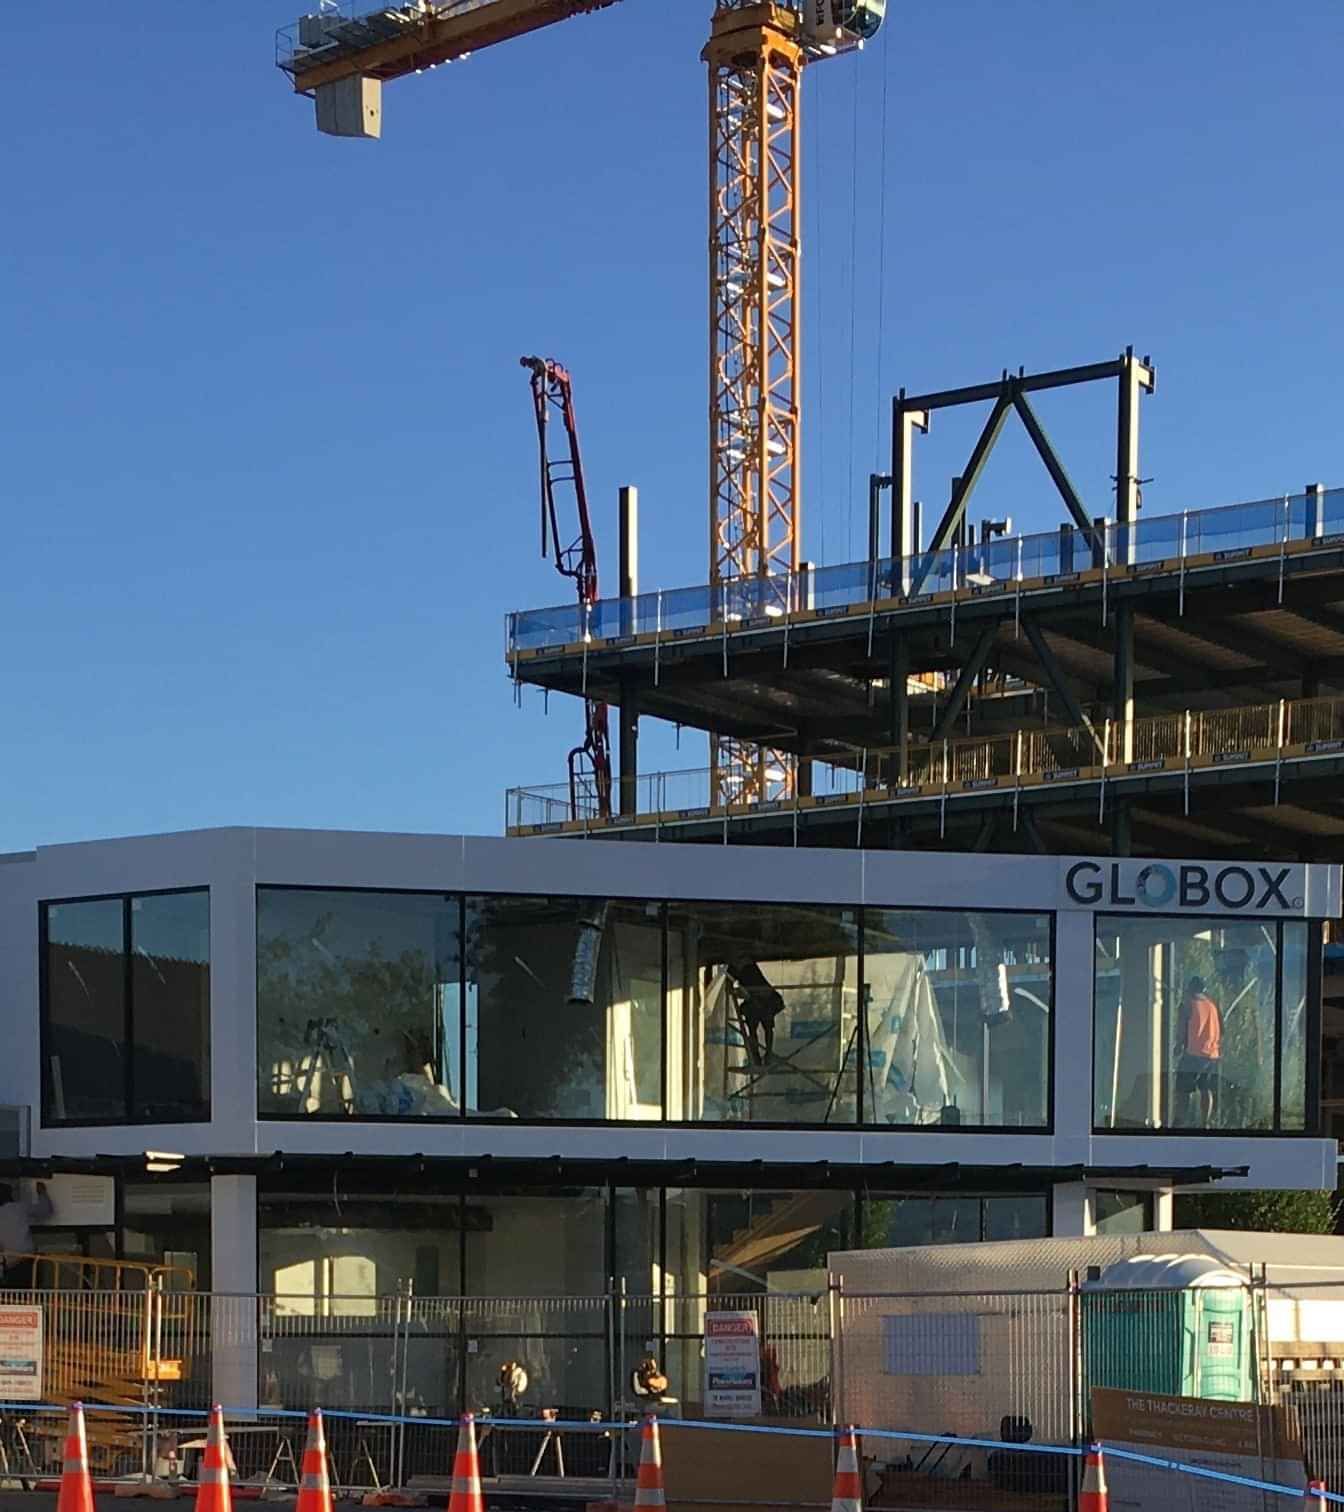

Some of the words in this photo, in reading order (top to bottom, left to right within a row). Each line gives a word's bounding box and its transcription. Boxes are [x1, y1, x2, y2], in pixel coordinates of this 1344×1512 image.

[1065, 861, 1292, 910] GLOBOX
[1126, 1398, 1147, 1413] THE
[1208, 1407, 1255, 1424] CENTRE
